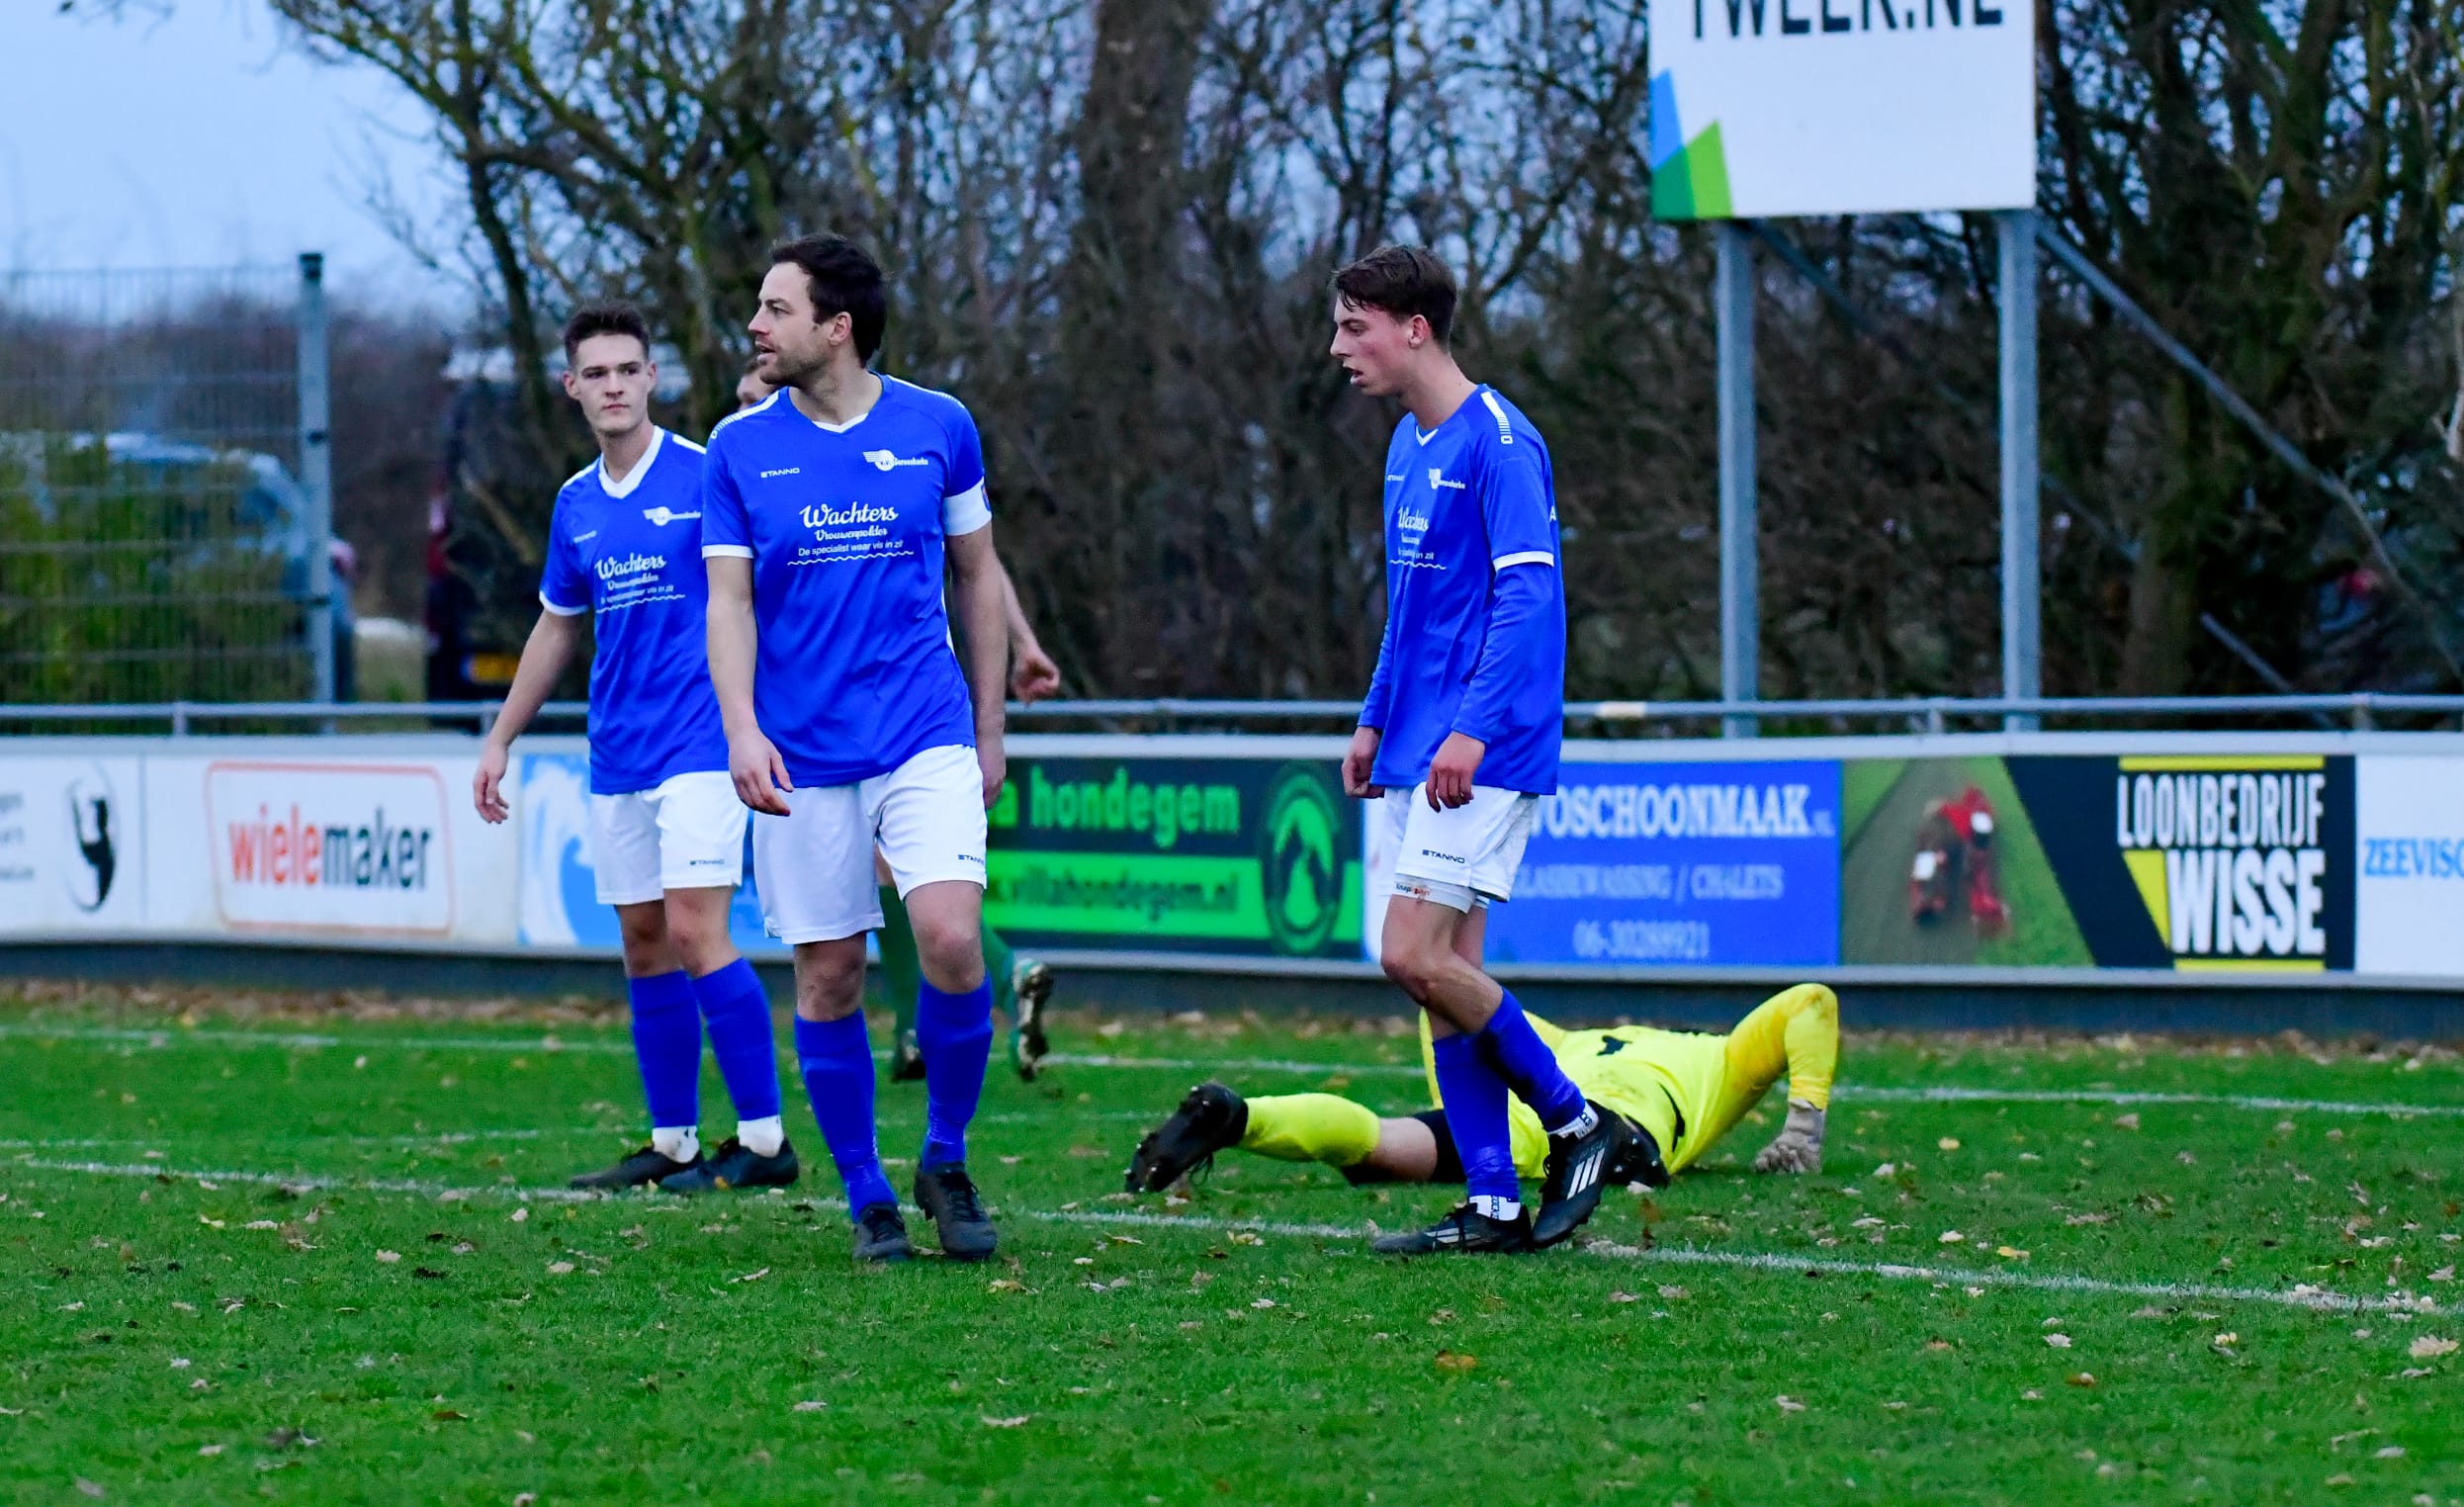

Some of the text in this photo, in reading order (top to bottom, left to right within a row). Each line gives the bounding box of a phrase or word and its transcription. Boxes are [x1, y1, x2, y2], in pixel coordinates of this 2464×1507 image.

[799, 501, 899, 528] Wachters
[594, 553, 667, 580] Wachters
[1030, 764, 1241, 847] hondegem
[2117, 773, 2327, 848] LOONBEDRIJF
[228, 803, 433, 888] wielemaker
[2165, 847, 2327, 955] WISSE
